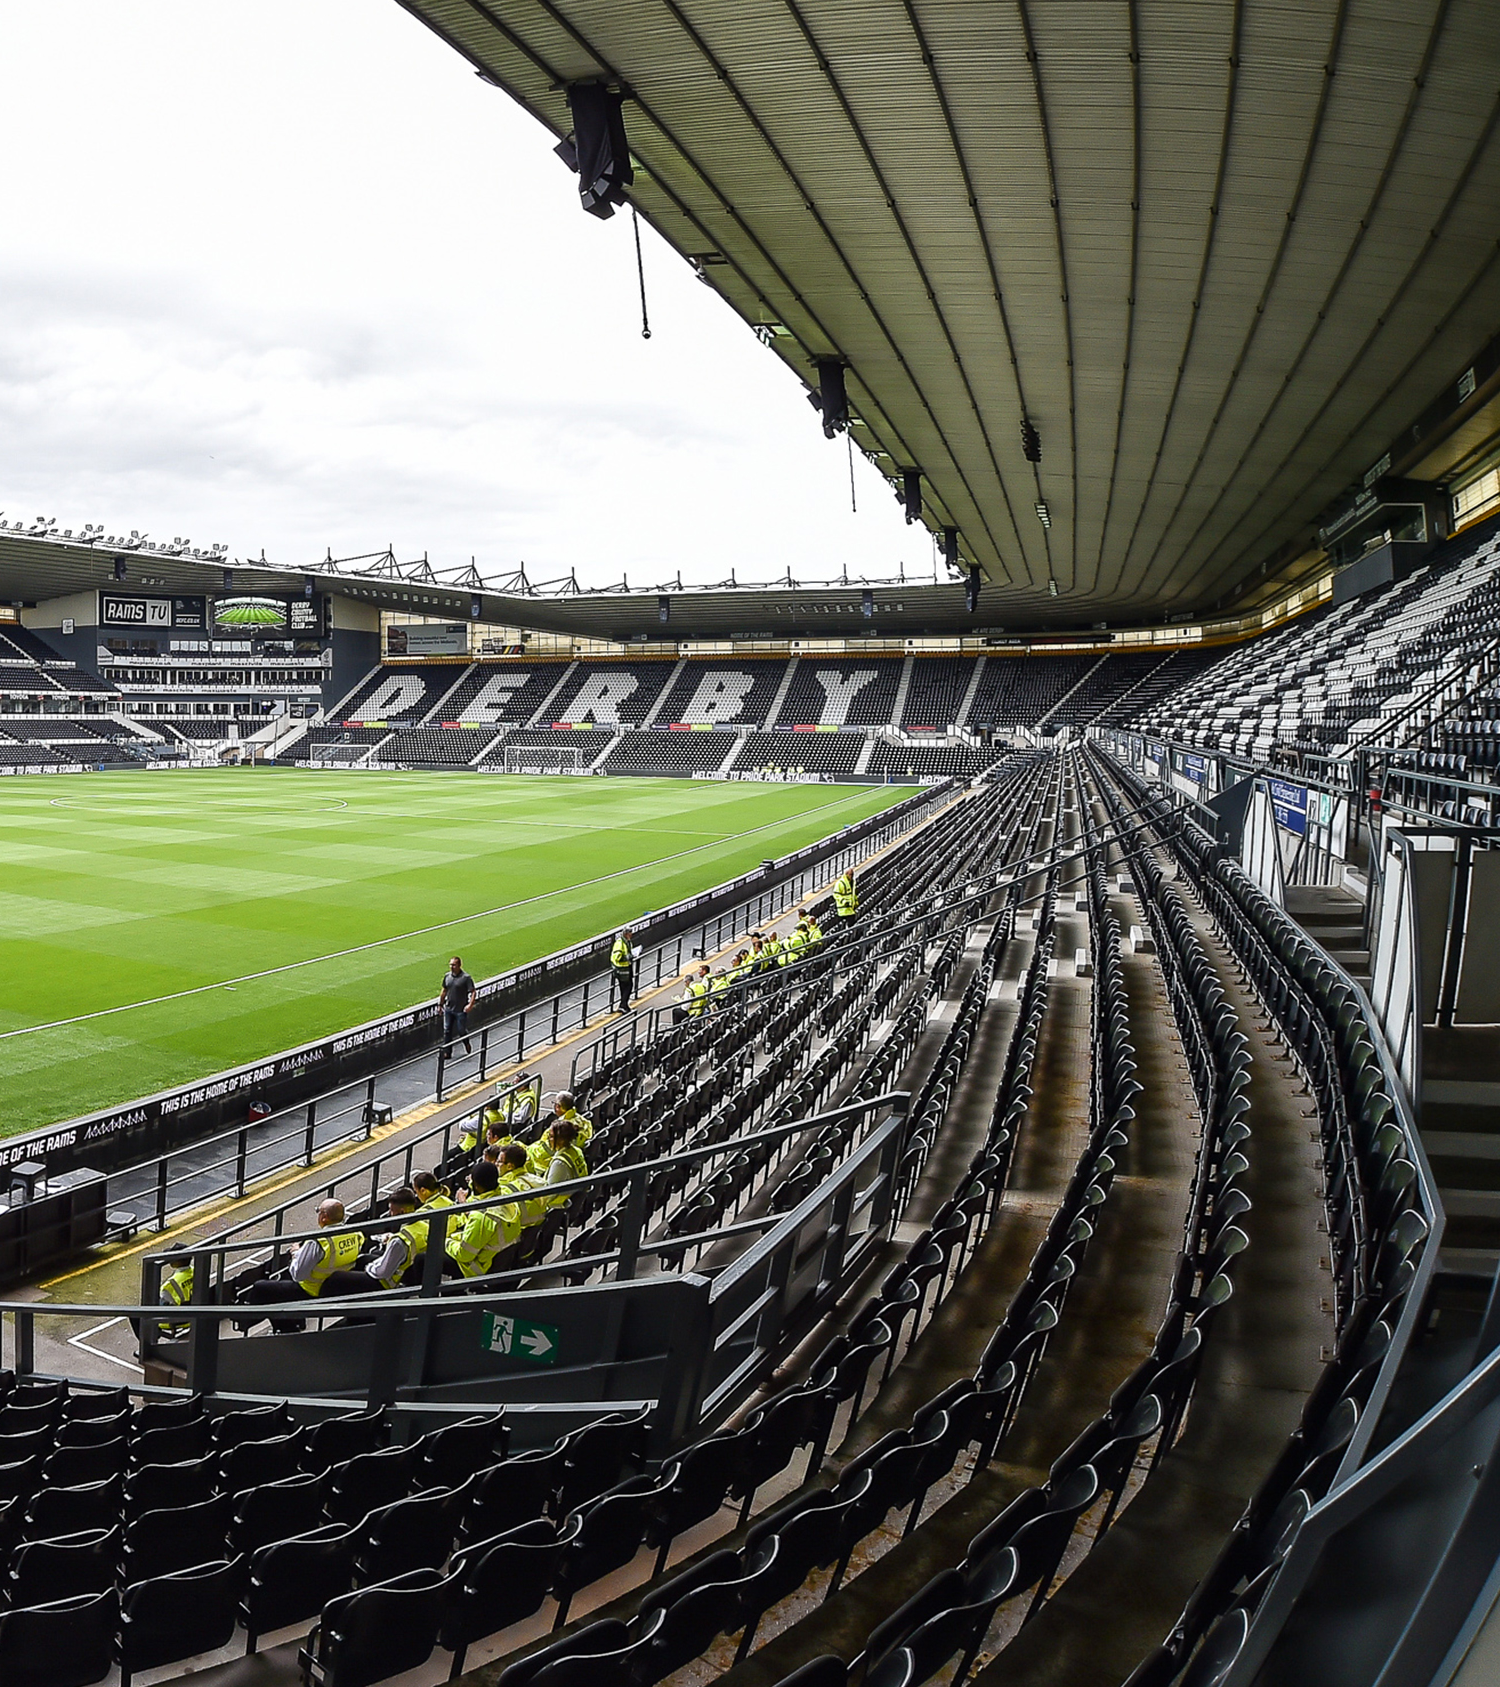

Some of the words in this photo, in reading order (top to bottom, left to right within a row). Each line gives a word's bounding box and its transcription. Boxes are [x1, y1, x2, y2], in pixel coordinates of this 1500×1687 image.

[108, 602, 144, 619] RAMS
[149, 605, 168, 619] TV
[291, 608, 313, 616] COUNTY
[350, 669, 878, 725] DERBY
[16, 766, 24, 775] TO
[25, 765, 43, 775] PRIDE
[43, 765, 57, 775] PARK
[58, 764, 83, 774] STADIUM
[511, 766, 520, 774] TO
[521, 766, 542, 775] PRIDE
[542, 766, 561, 775] PARK
[562, 767, 593, 776] STADIUM
[691, 770, 728, 780] WELCOME
[729, 771, 739, 781] TO
[740, 770, 764, 781] PRIDE
[764, 771, 785, 782] PARK
[786, 772, 820, 783] STADIUM
[333, 1039, 347, 1054] THIS
[346, 1036, 353, 1049] IS
[353, 1032, 365, 1047] THE
[364, 1027, 381, 1042] HOME
[380, 1024, 389, 1036] OF
[388, 1020, 400, 1033] THE
[398, 1014, 415, 1029] RAMS
[160, 1097, 180, 1115] THIS
[180, 1093, 190, 1109] IS
[190, 1088, 206, 1106] THE
[205, 1082, 229, 1100] HOME
[228, 1078, 239, 1092] OF
[239, 1072, 254, 1089] THE
[253, 1064, 276, 1082] RAMS
[10, 1147, 25, 1163] OF
[25, 1139, 47, 1159] THE
[46, 1130, 77, 1152] RAMS
[338, 1237, 356, 1249] CREW
